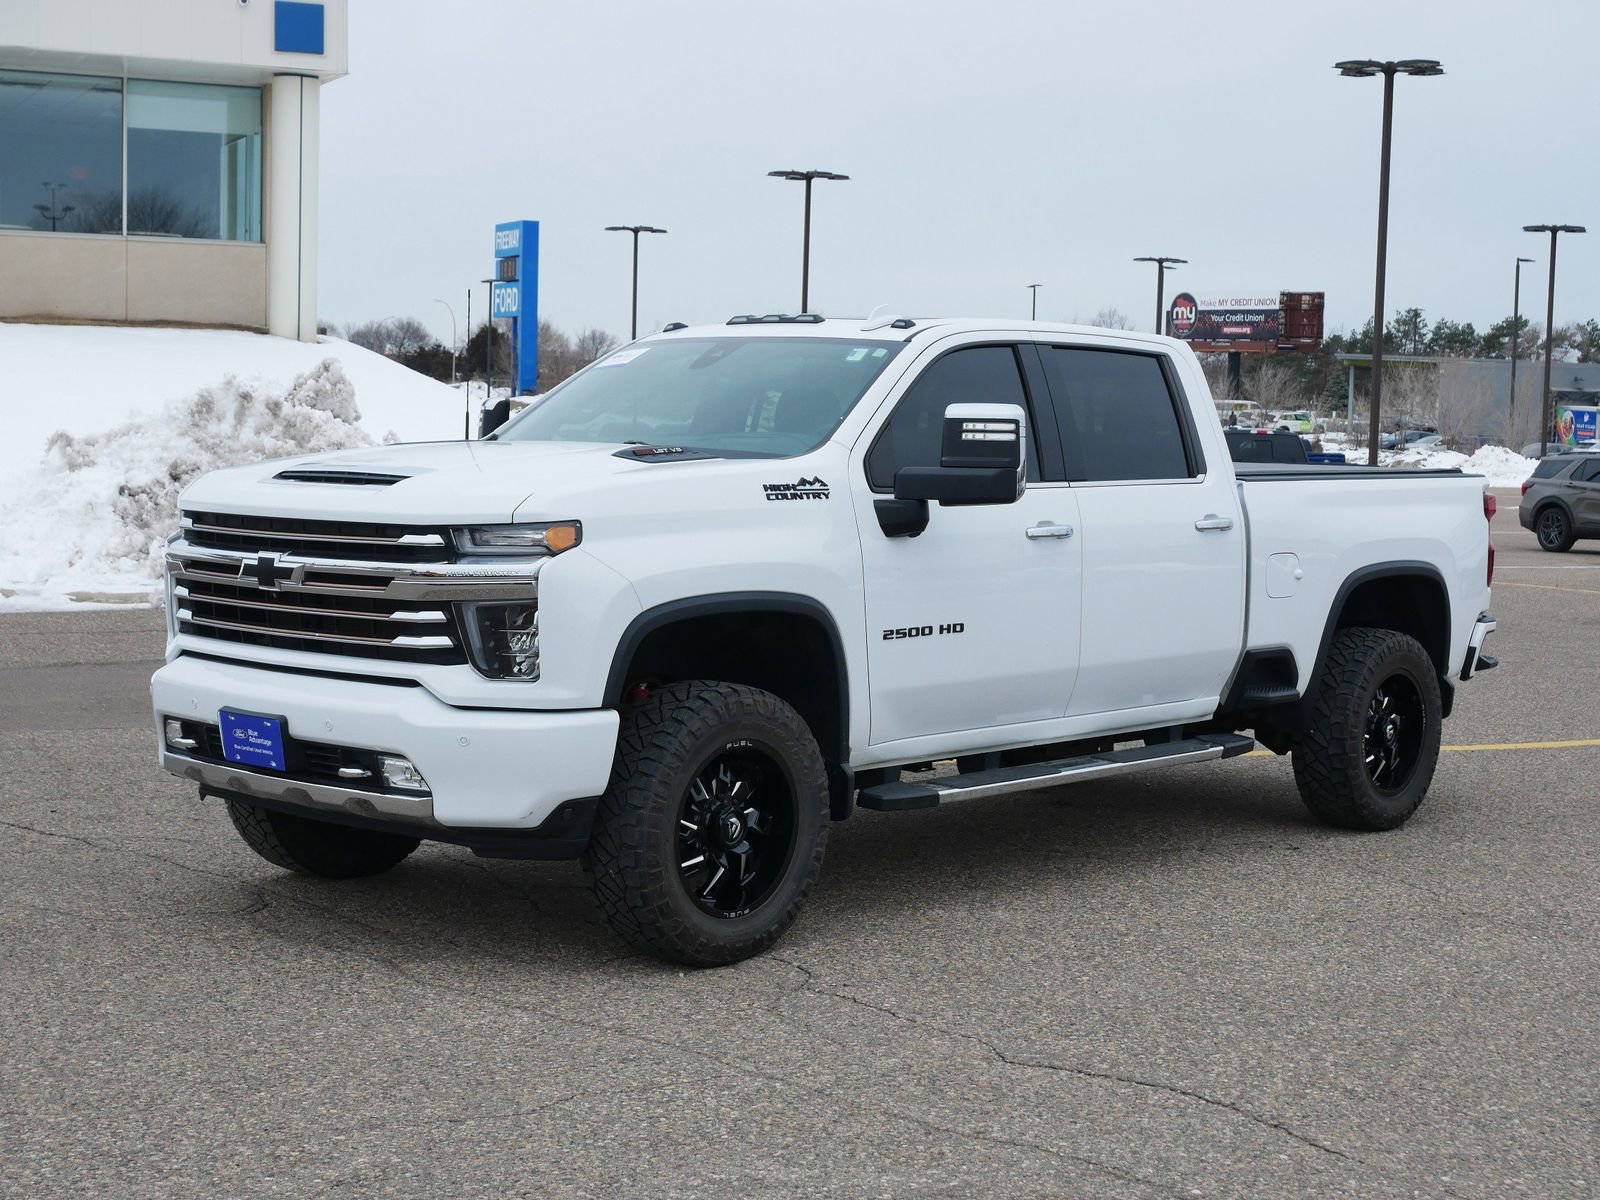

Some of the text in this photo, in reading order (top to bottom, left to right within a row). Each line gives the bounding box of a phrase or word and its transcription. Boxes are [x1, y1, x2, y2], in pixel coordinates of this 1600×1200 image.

[496, 229, 519, 250] FREEWAY
[495, 287, 518, 313] FORD
[1218, 298, 1228, 306] MY
[1230, 298, 1252, 306] CREDIT
[1254, 298, 1276, 306] UNION
[1173, 306, 1195, 324] my
[1211, 313, 1264, 322] Your Credit Union!
[763, 484, 798, 492] HIGH
[766, 492, 830, 500] COUNTRY
[882, 623, 965, 640] 2500 HD
[249, 736, 272, 746] Advantage
[726, 740, 752, 749] FUEL
[723, 908, 750, 918] FUEL
